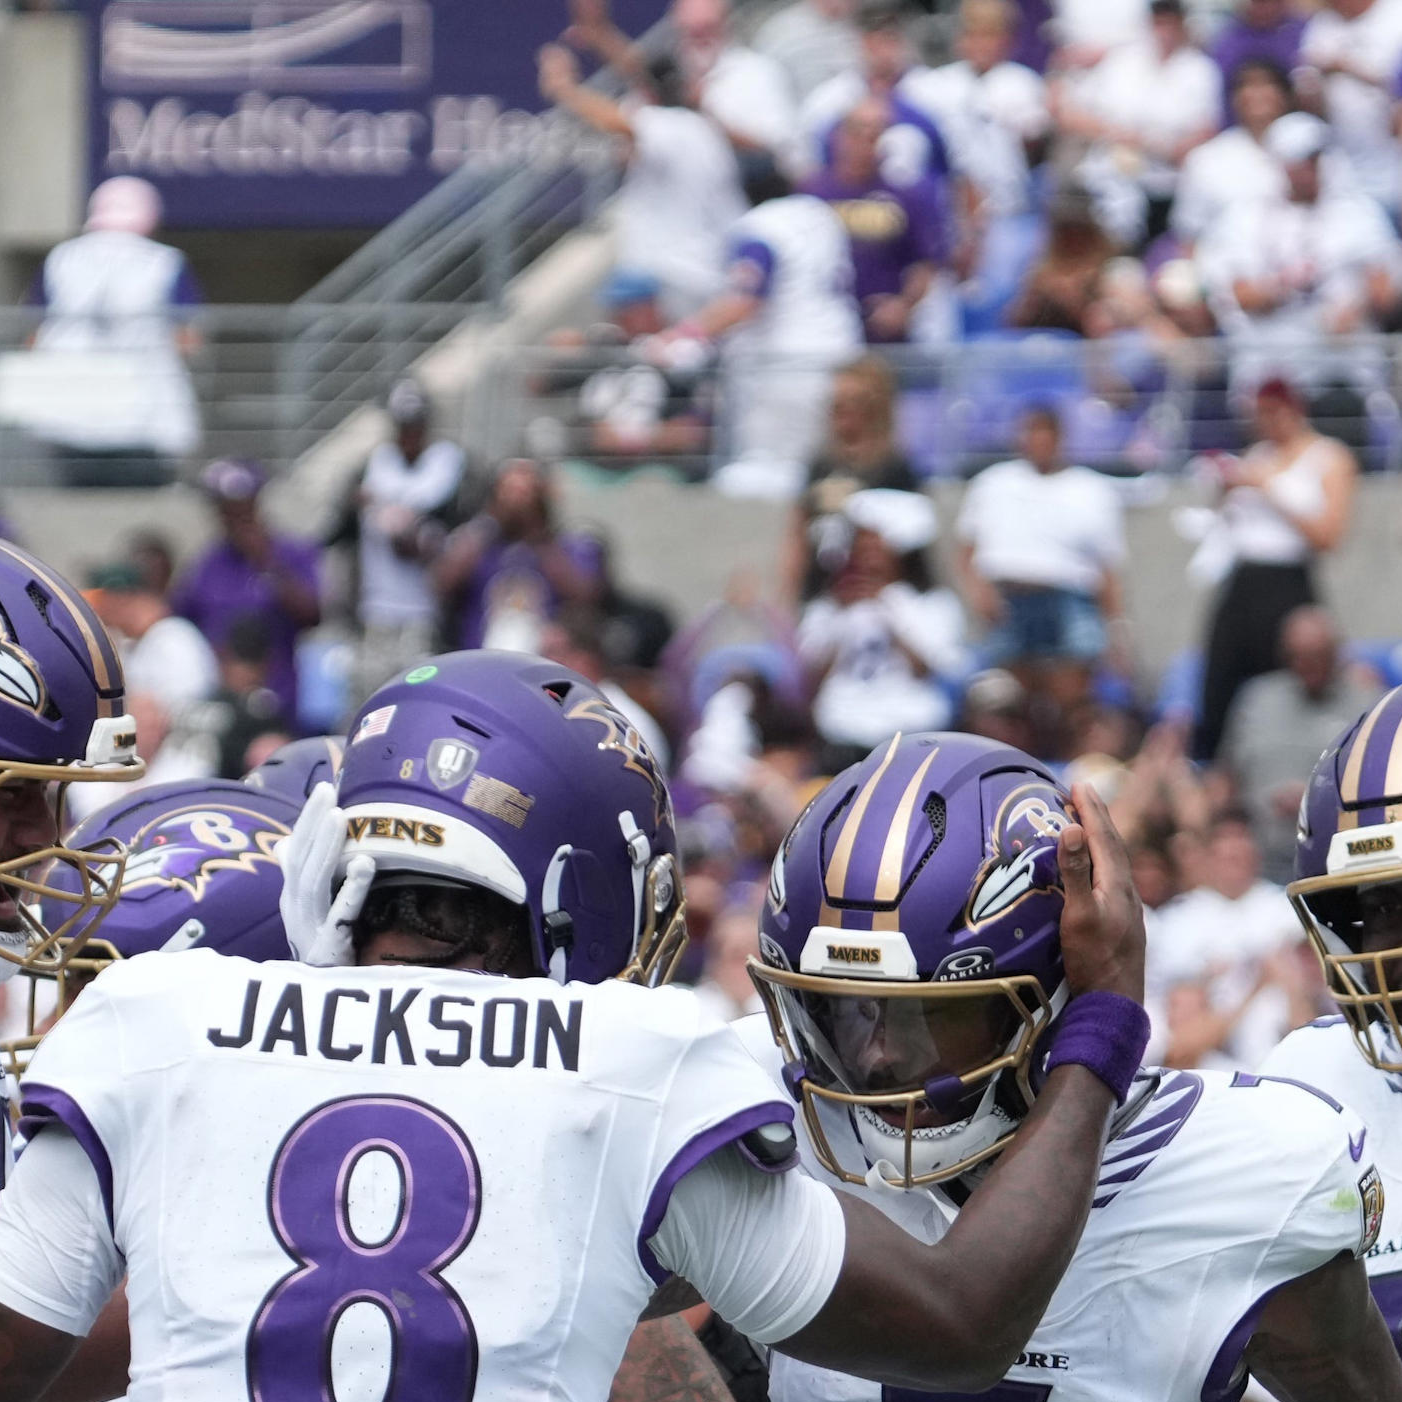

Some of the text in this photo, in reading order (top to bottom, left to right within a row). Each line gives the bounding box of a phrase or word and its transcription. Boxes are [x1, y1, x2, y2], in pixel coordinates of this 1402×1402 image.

[106, 90, 428, 177] MedStar
[399, 758, 414, 779] 8
[346, 815, 446, 848] VENS
[1346, 835, 1396, 856] RAVENS
[826, 944, 882, 964] RAVENS
[939, 962, 991, 982] OAKLEY
[206, 979, 584, 1072] JACKSON
